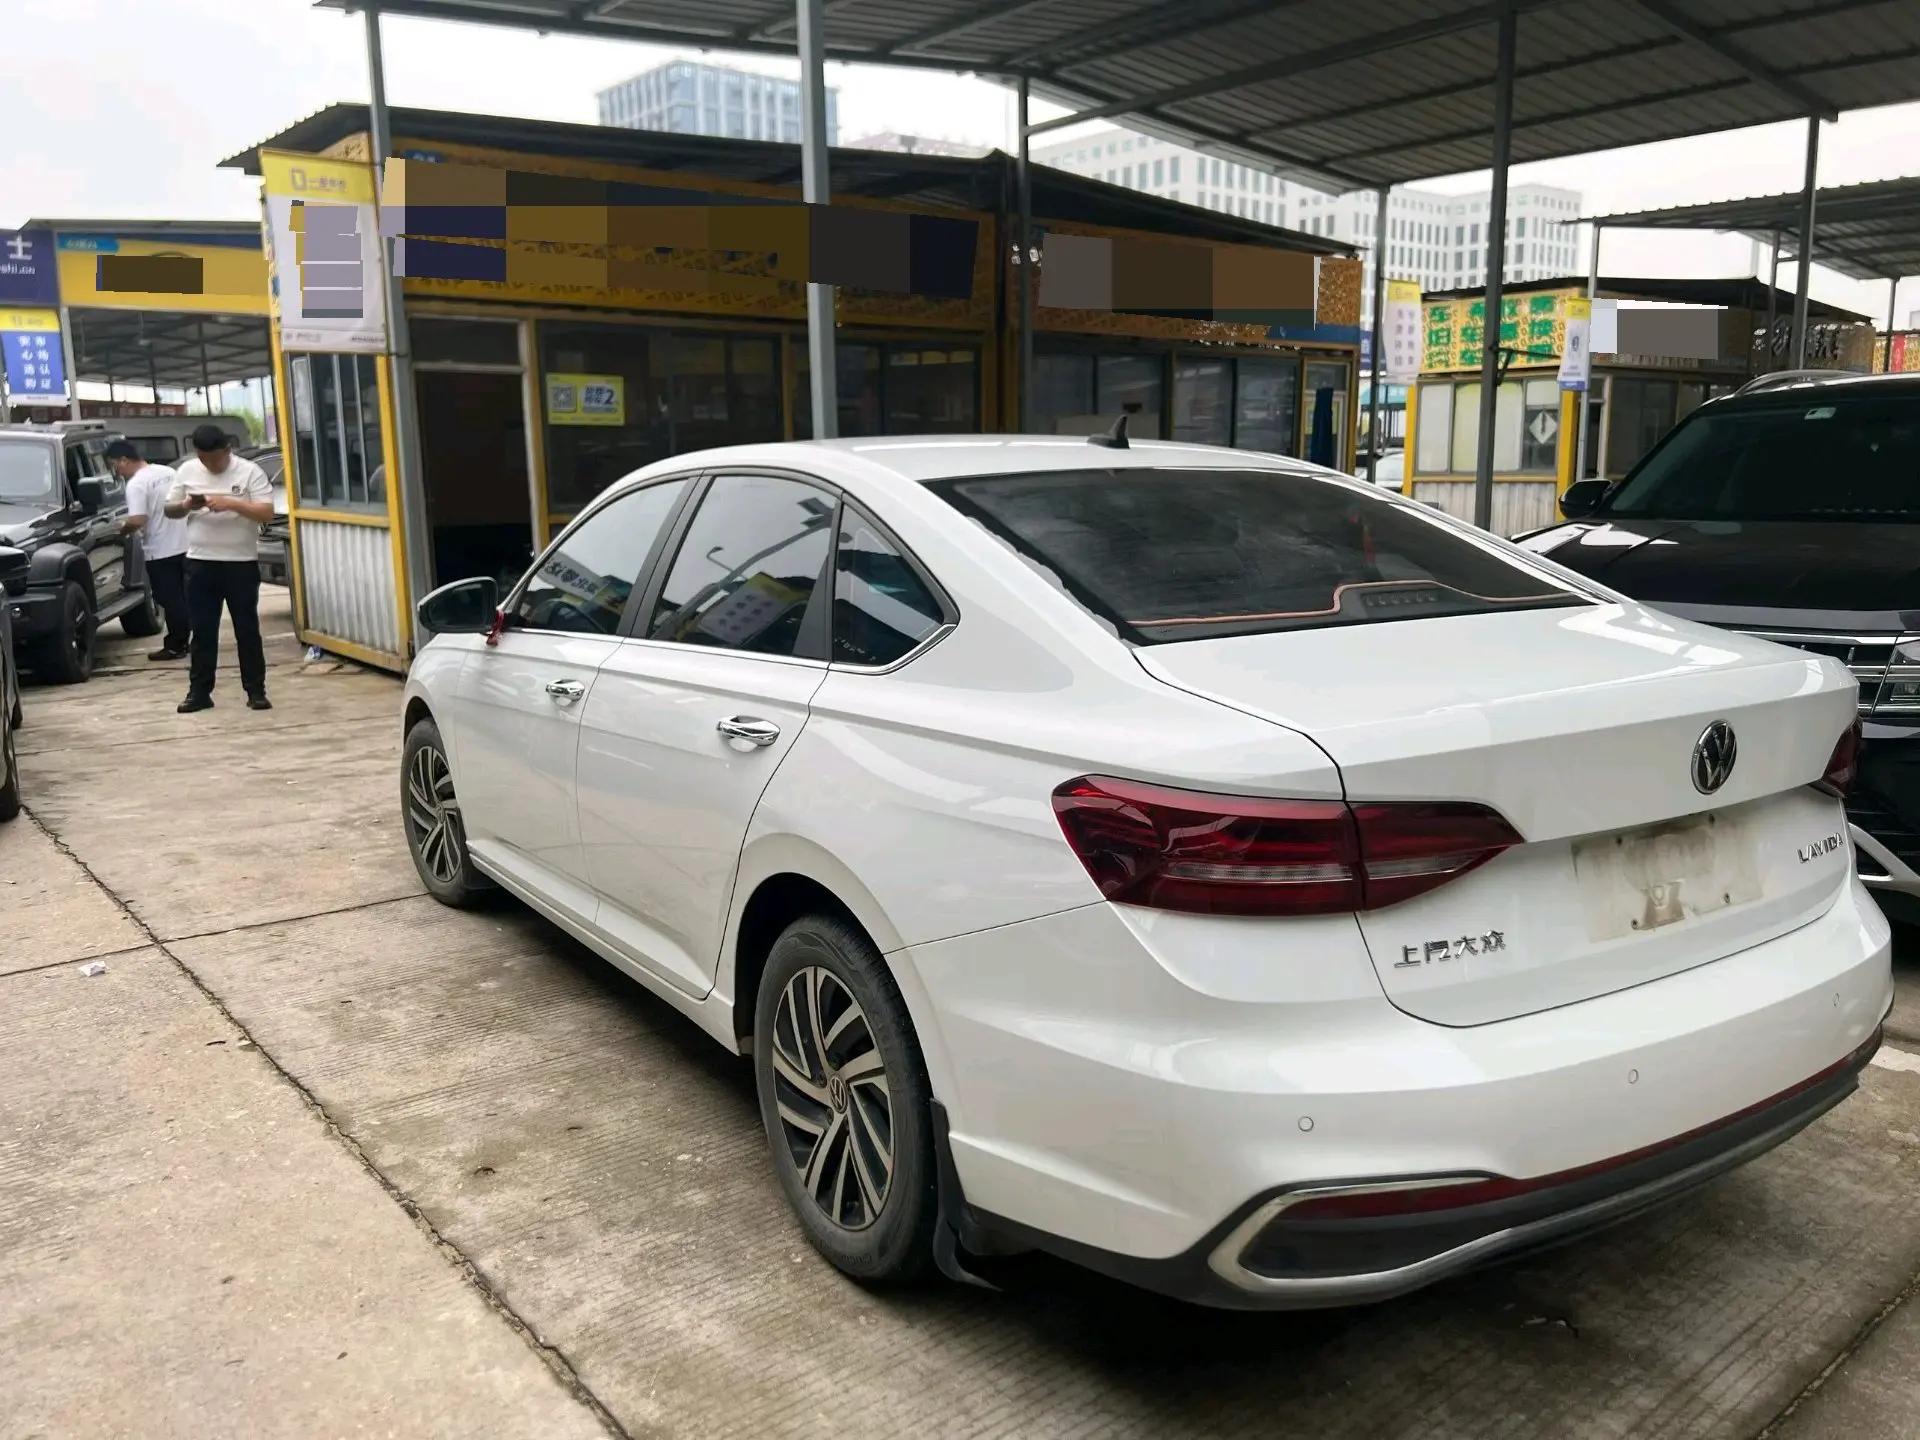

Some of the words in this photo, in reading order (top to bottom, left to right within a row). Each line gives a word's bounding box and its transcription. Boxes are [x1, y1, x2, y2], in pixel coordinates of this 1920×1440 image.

[1797, 832, 1844, 864] LAVIDA
[1393, 928, 1506, 968] 上汽大众
